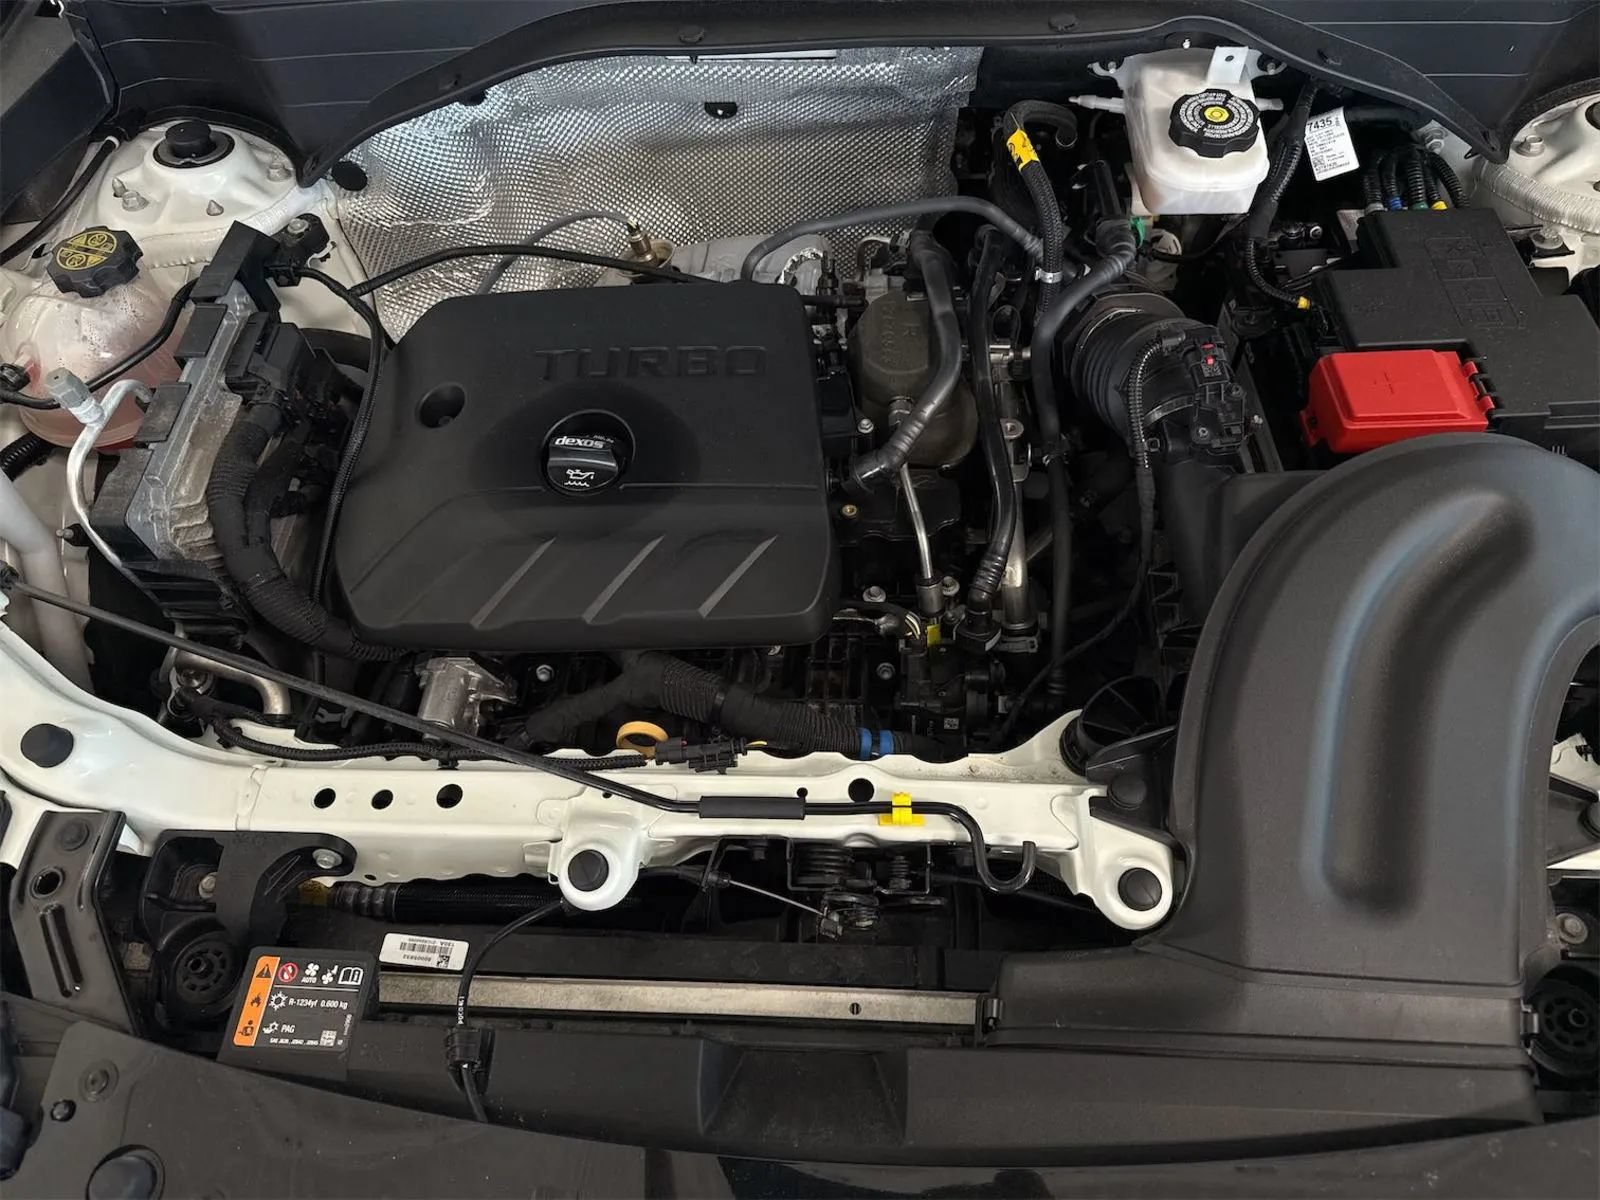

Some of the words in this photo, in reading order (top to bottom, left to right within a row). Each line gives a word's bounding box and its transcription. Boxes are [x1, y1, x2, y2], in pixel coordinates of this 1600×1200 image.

[1307, 116, 1333, 132] 7435
[535, 344, 768, 381] TURBO
[554, 435, 606, 449] dexos
[288, 997, 318, 1009] R-1234yf
[339, 1001, 348, 1010] kg
[281, 1024, 296, 1033] PAG
